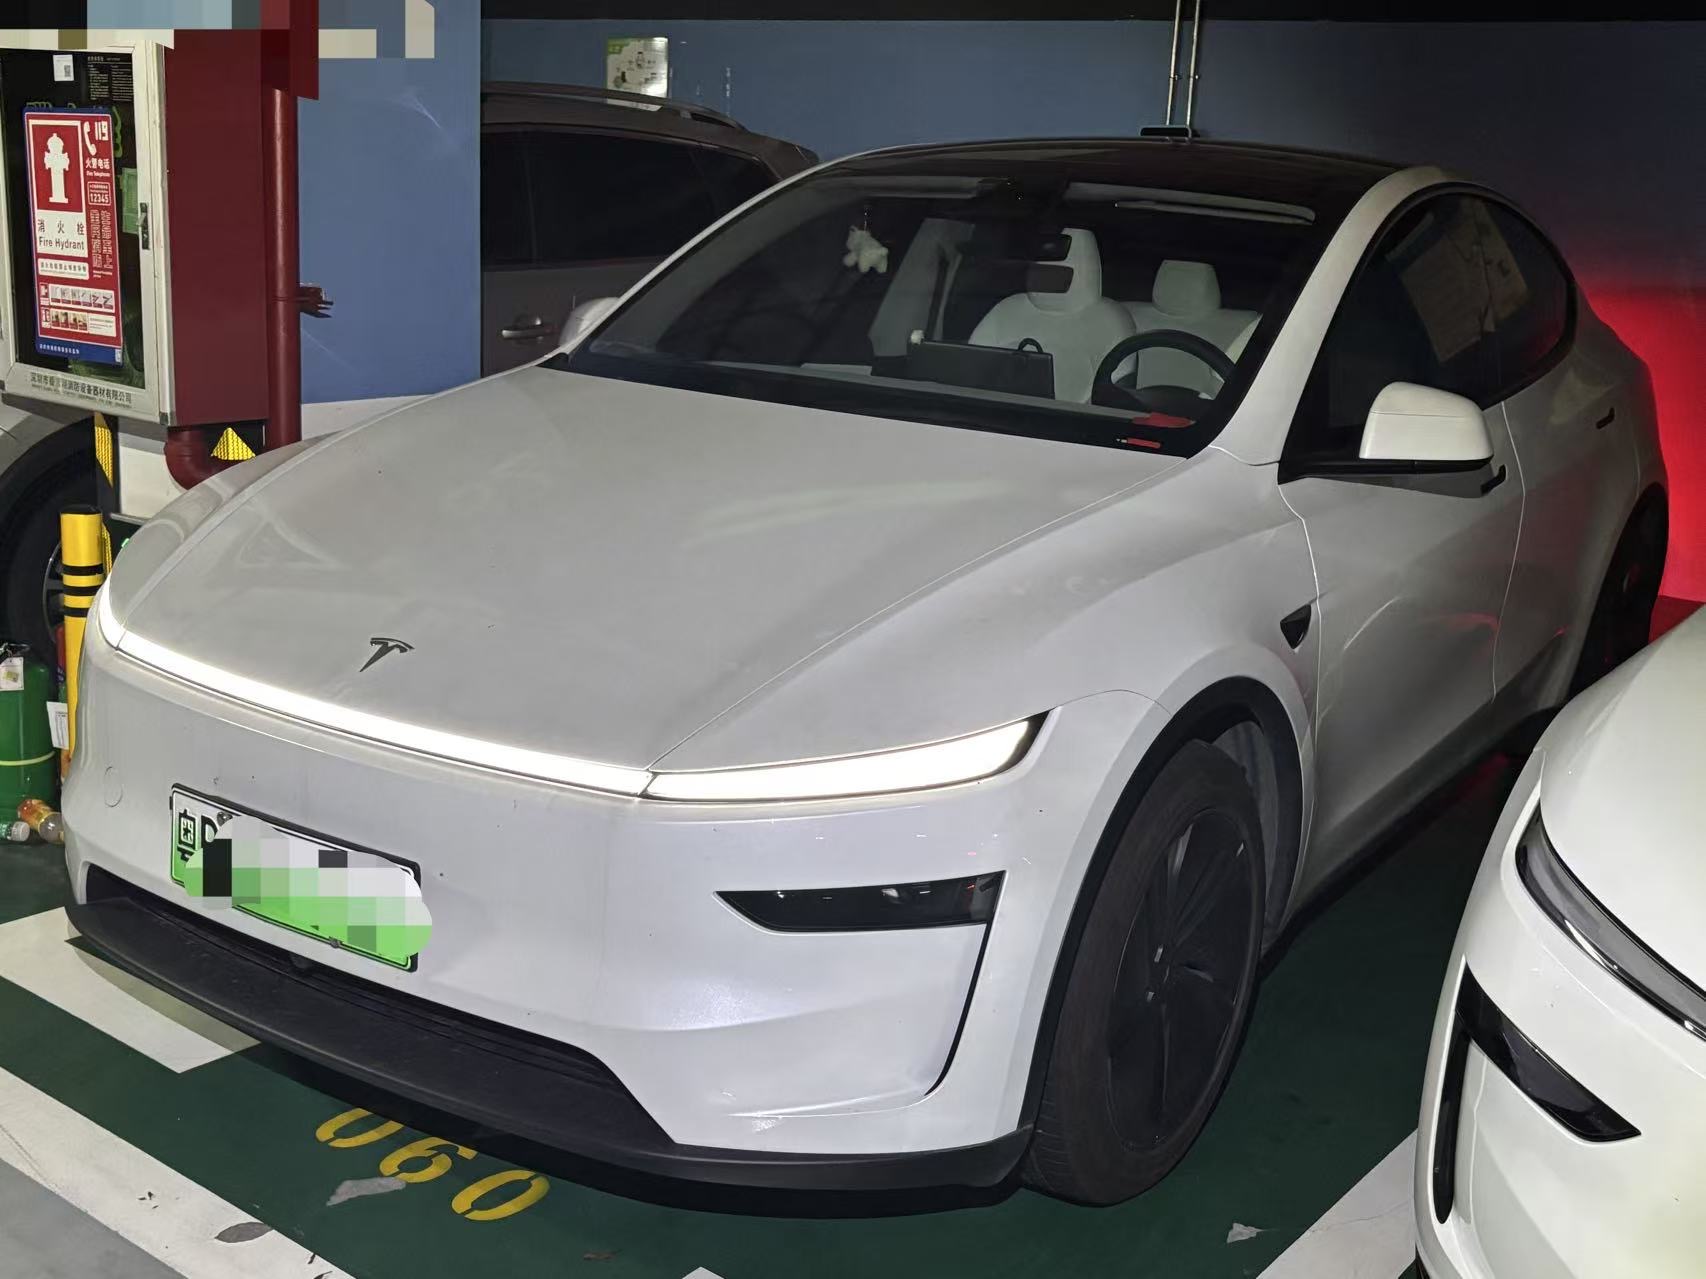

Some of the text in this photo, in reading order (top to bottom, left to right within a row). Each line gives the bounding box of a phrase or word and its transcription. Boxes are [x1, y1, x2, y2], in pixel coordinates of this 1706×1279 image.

[95, 121, 109, 141] 119
[85, 158, 110, 169] 火警电话
[90, 193, 109, 203] 12345
[39, 236, 85, 250] Fire Hydrant
[30, 371, 132, 404] 深圳市消防设备器材有限公司
